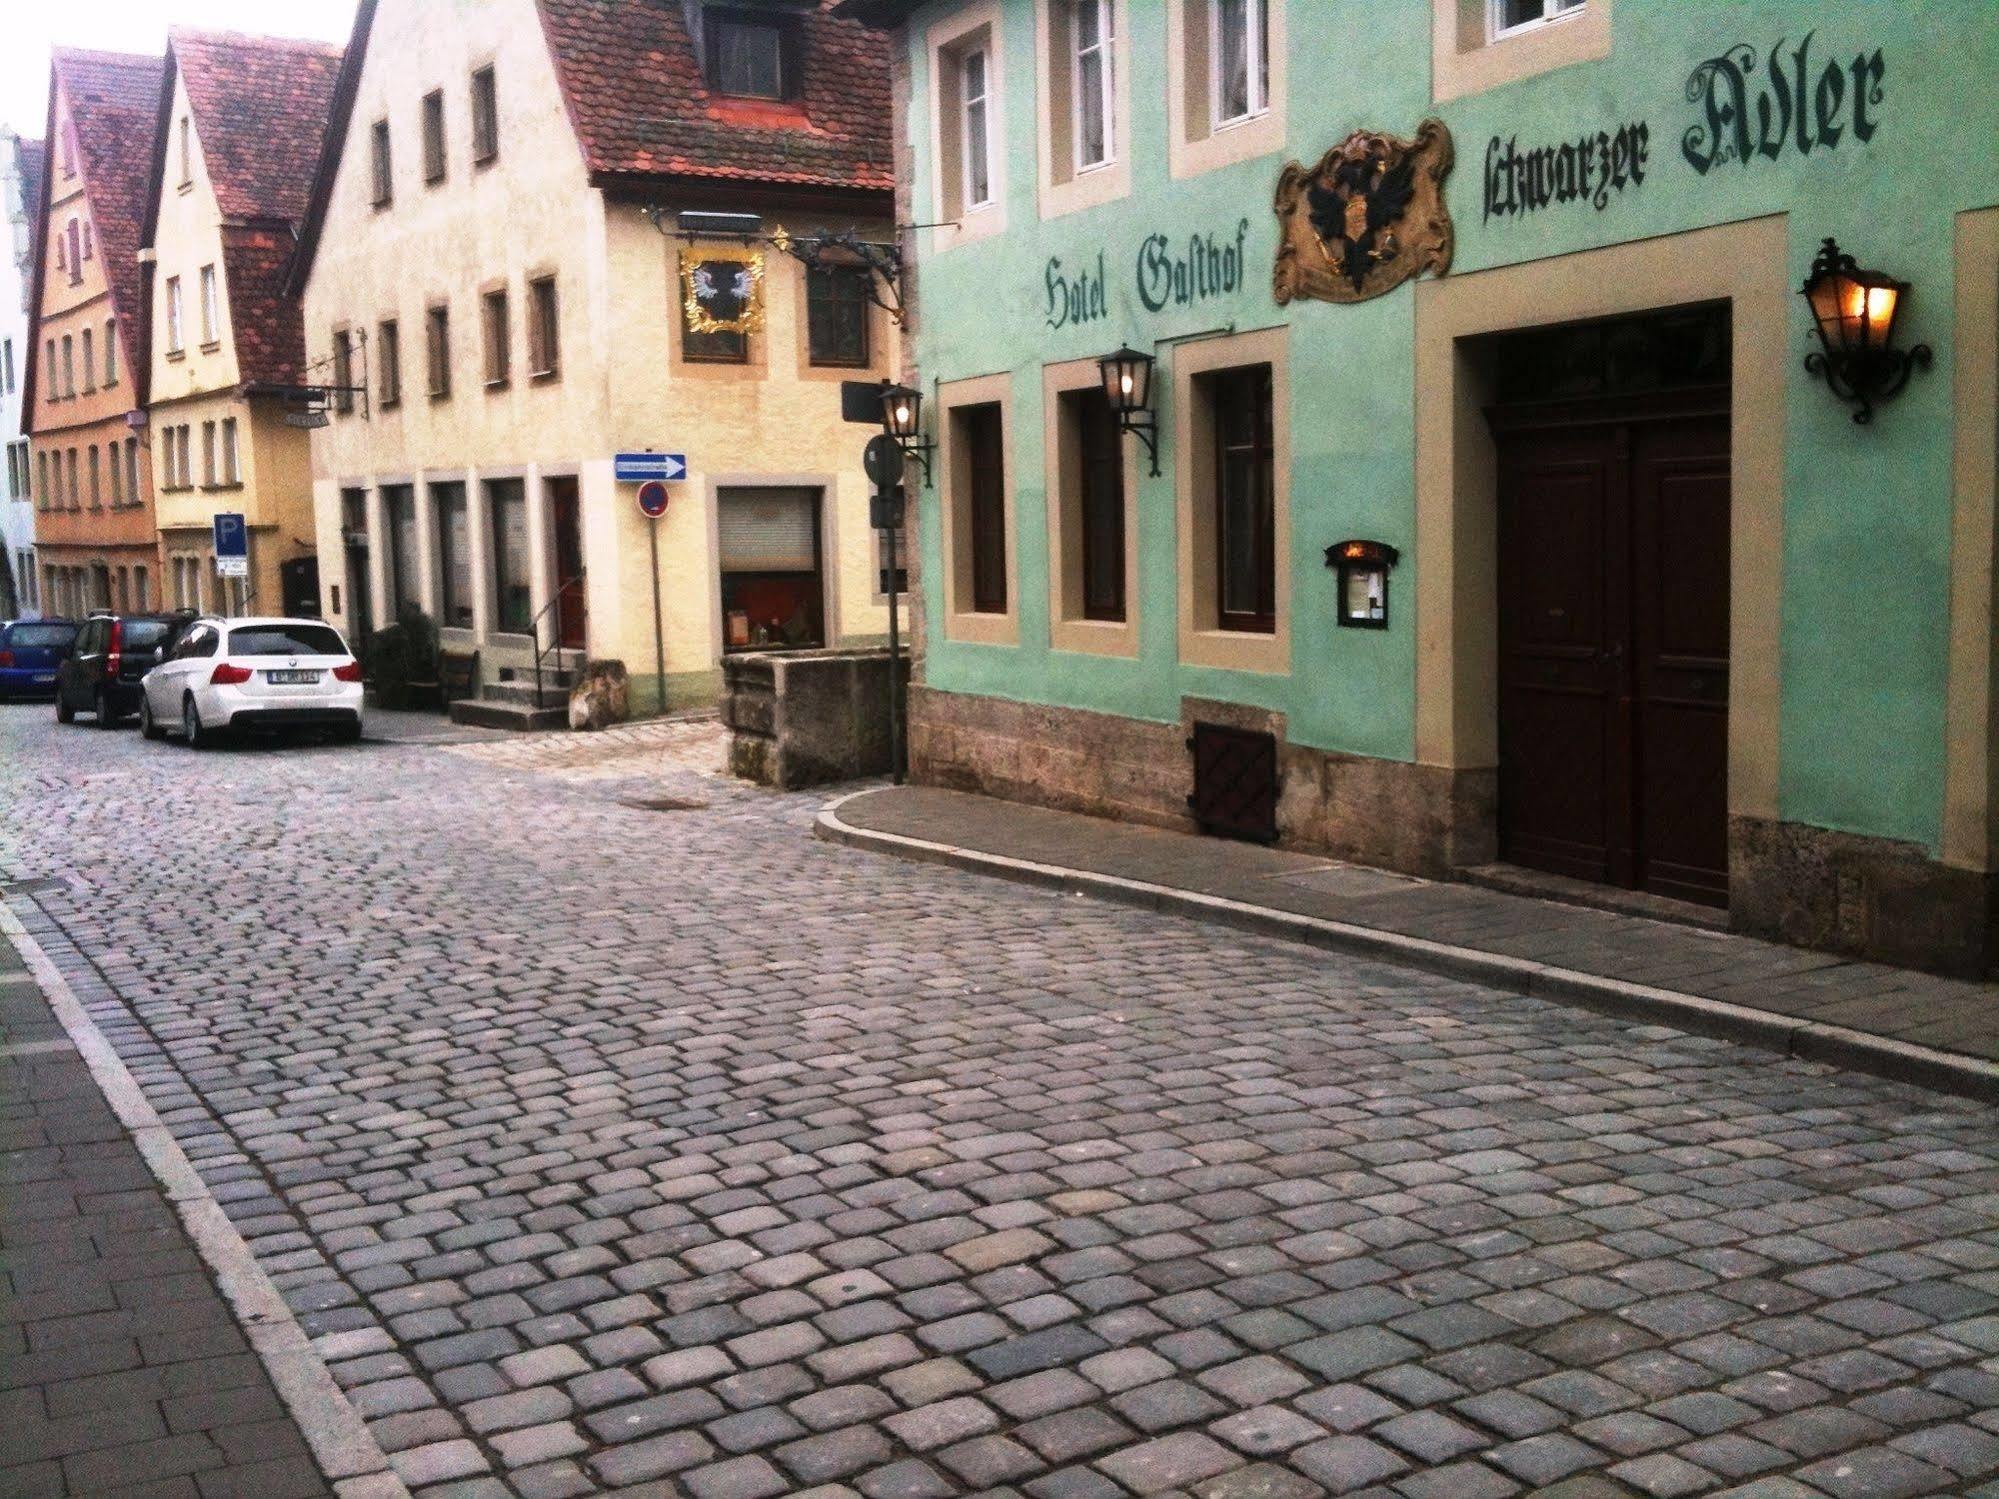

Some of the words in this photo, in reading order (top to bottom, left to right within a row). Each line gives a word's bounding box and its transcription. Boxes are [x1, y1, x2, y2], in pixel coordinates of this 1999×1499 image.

[1682, 30, 1885, 176] Adler
[1045, 249, 1107, 329] Hotel
[1137, 218, 1248, 312] Gasthof
[221, 518, 237, 544] P
